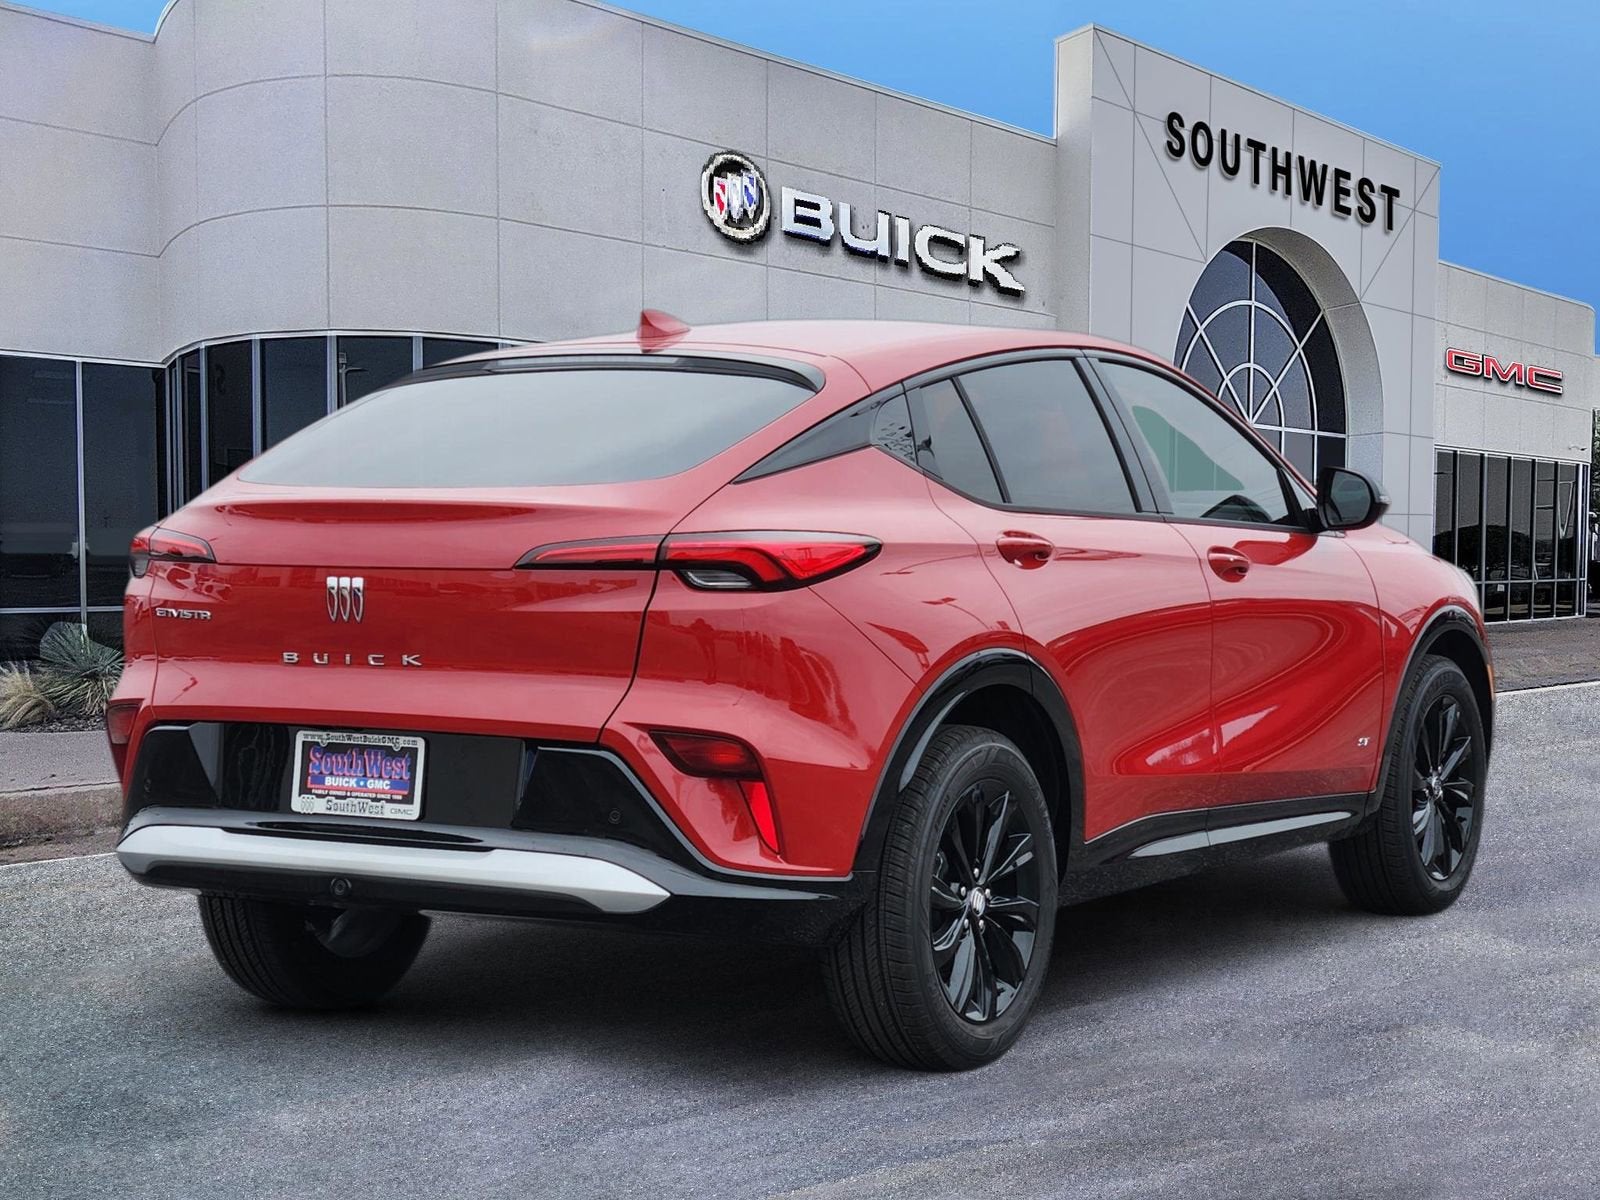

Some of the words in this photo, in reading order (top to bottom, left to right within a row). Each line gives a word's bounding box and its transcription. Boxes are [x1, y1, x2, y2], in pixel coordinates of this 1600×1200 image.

[1166, 111, 1400, 231] SOUTHWEST
[781, 186, 1025, 297] BUICK
[1445, 347, 1563, 394] GMC
[282, 651, 422, 667] BUICK
[308, 745, 411, 779] SouthWest
[324, 776, 357, 788] BUICK
[366, 779, 391, 790] GMC
[325, 799, 385, 816] SouthWest
[390, 807, 414, 816] GMC
